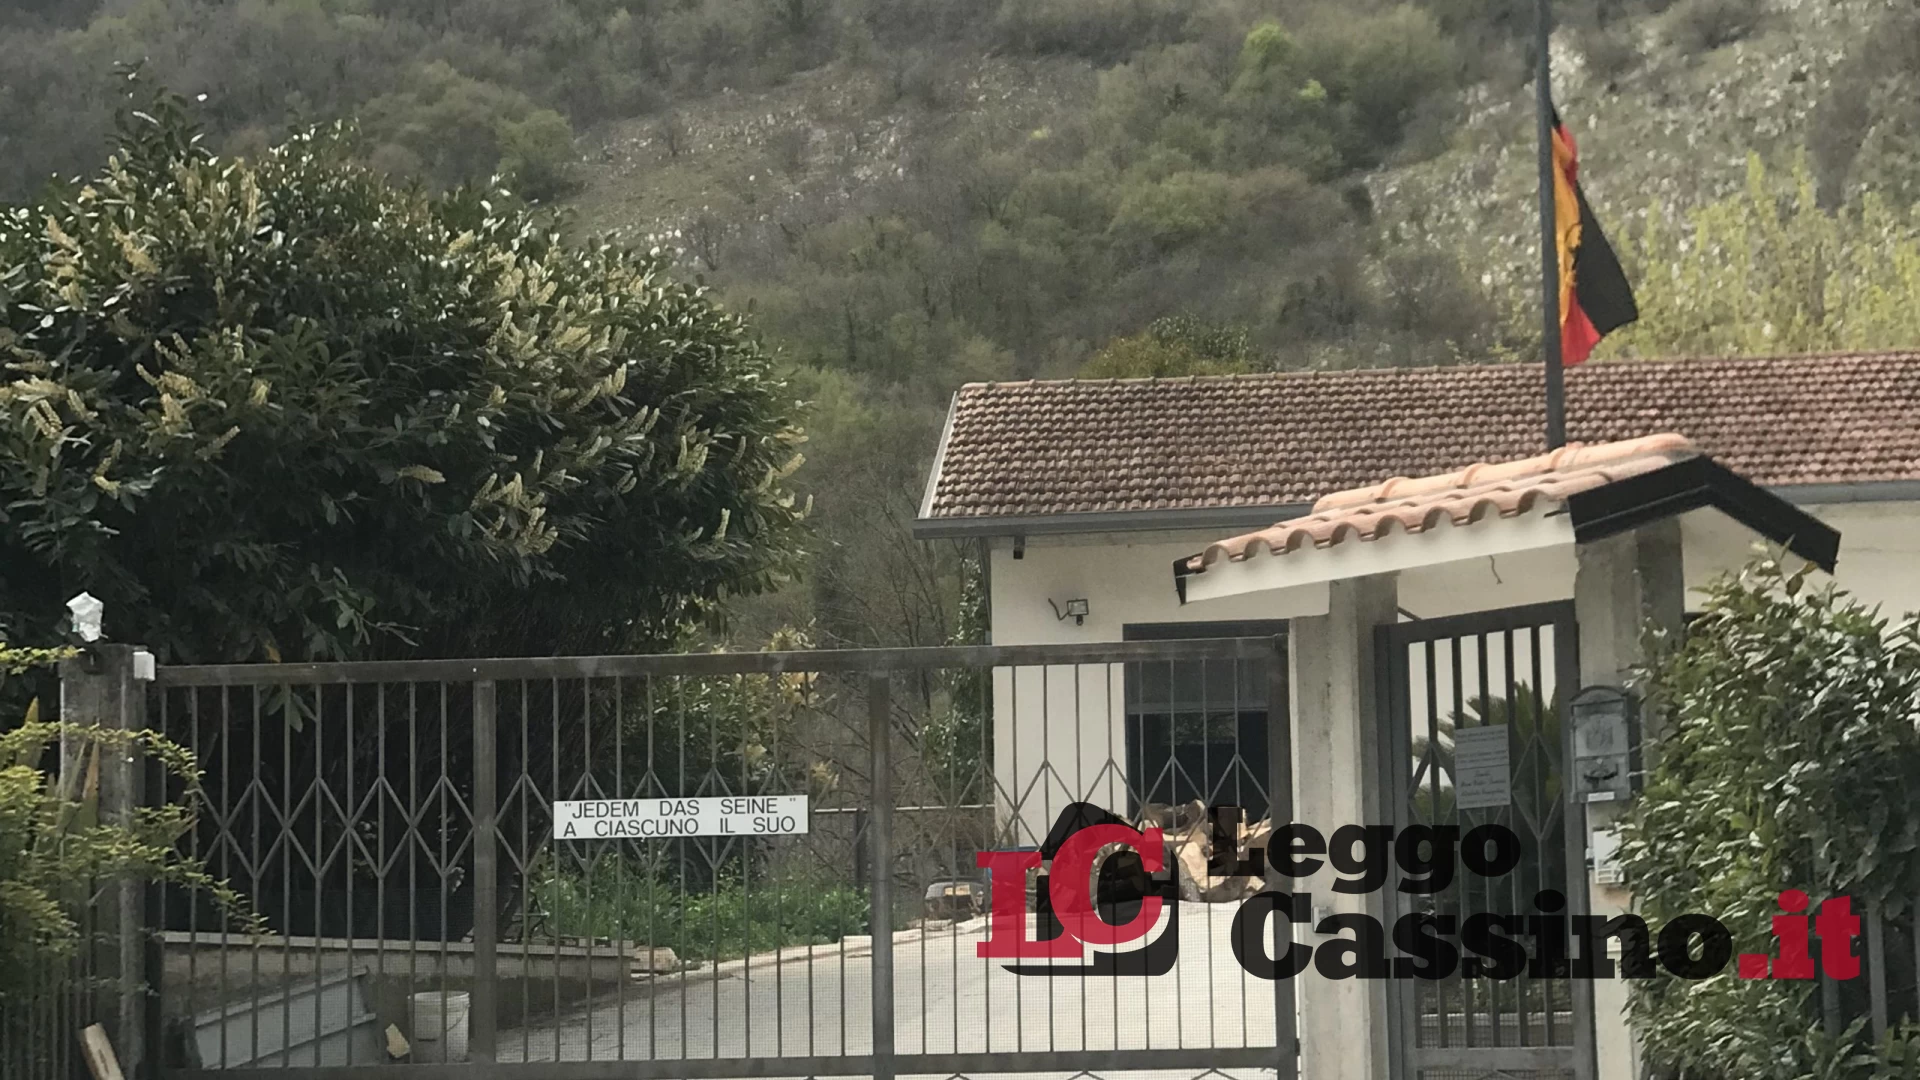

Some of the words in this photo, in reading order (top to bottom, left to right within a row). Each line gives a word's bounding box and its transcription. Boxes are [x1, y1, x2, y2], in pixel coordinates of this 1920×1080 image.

[659, 800, 700, 816] DAS
[563, 821, 577, 837] A
[594, 818, 699, 836] CIASCUNO
[720, 817, 735, 833] IL
[752, 816, 796, 833] SUO
